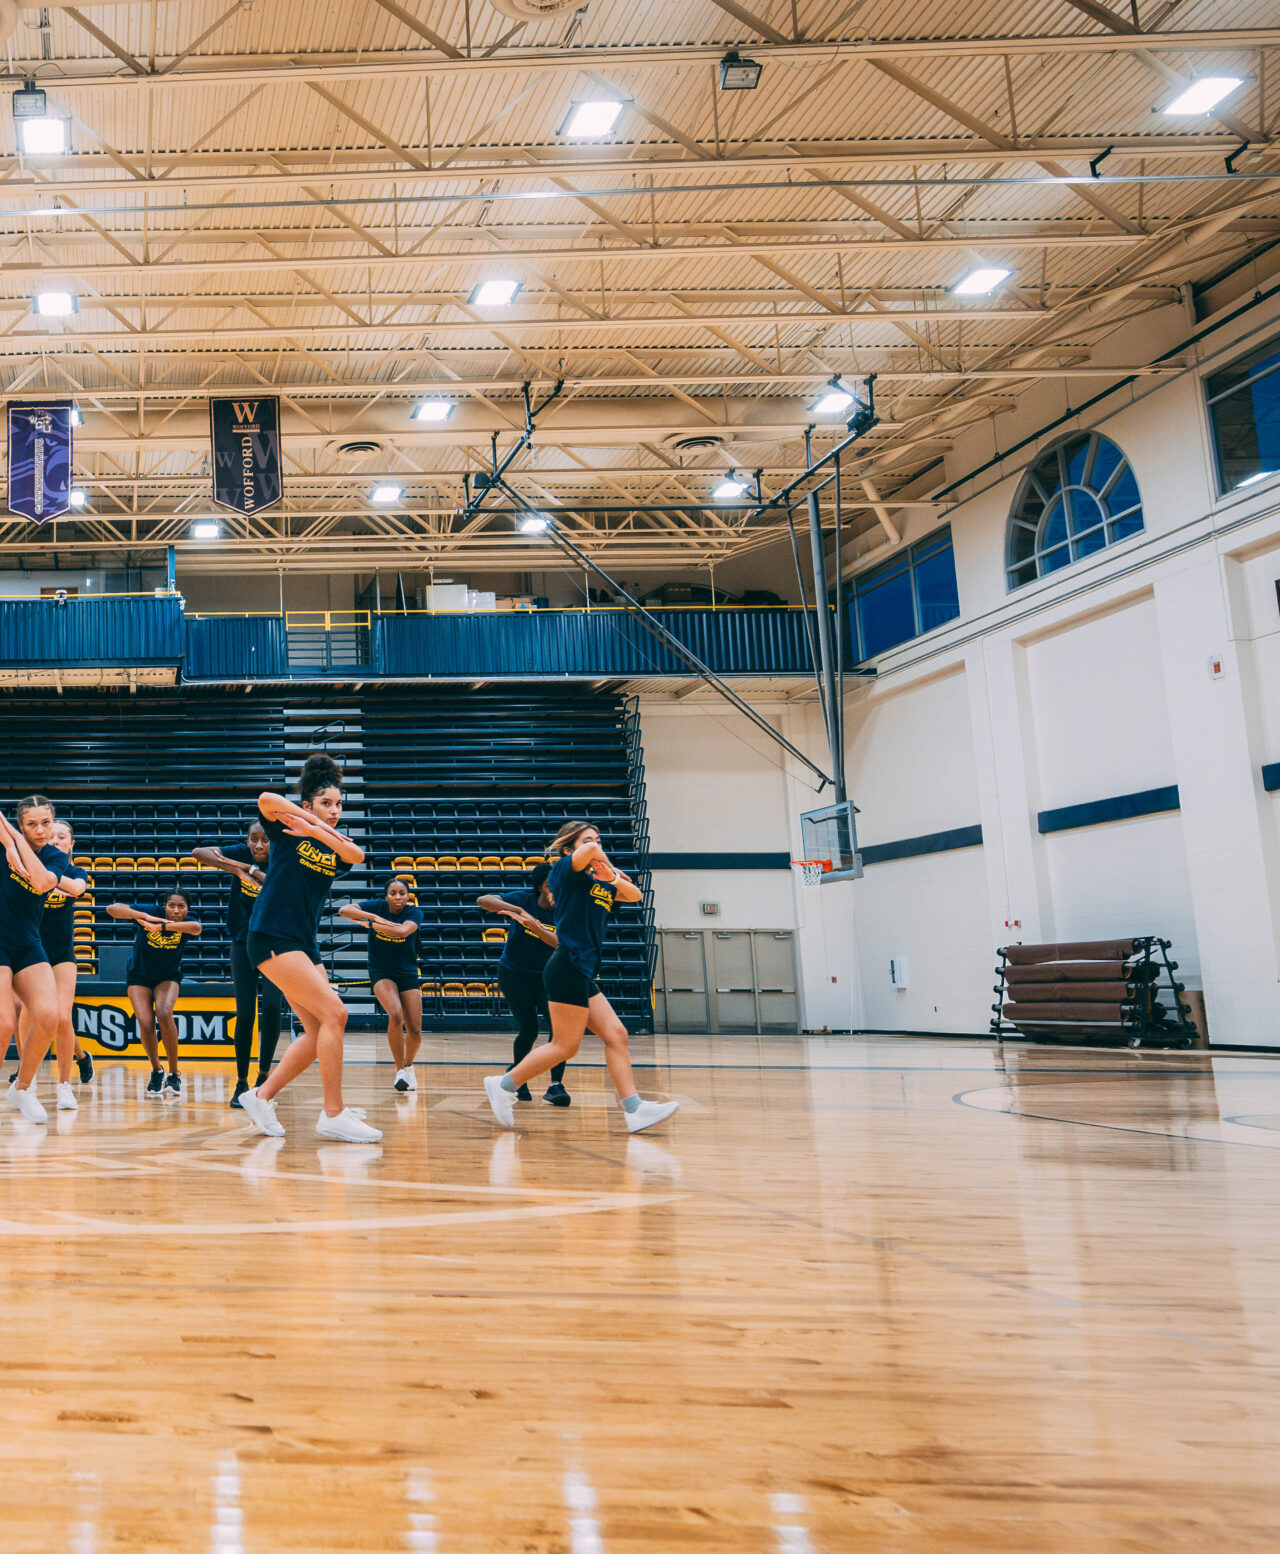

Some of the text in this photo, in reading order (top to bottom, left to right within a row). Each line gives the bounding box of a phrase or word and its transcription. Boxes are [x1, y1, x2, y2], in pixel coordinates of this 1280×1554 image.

[232, 402, 259, 423] W
[242, 436, 255, 510] WOFFORD
[299, 858, 322, 873] DANCE
[9, 873, 29, 890] DANCE
